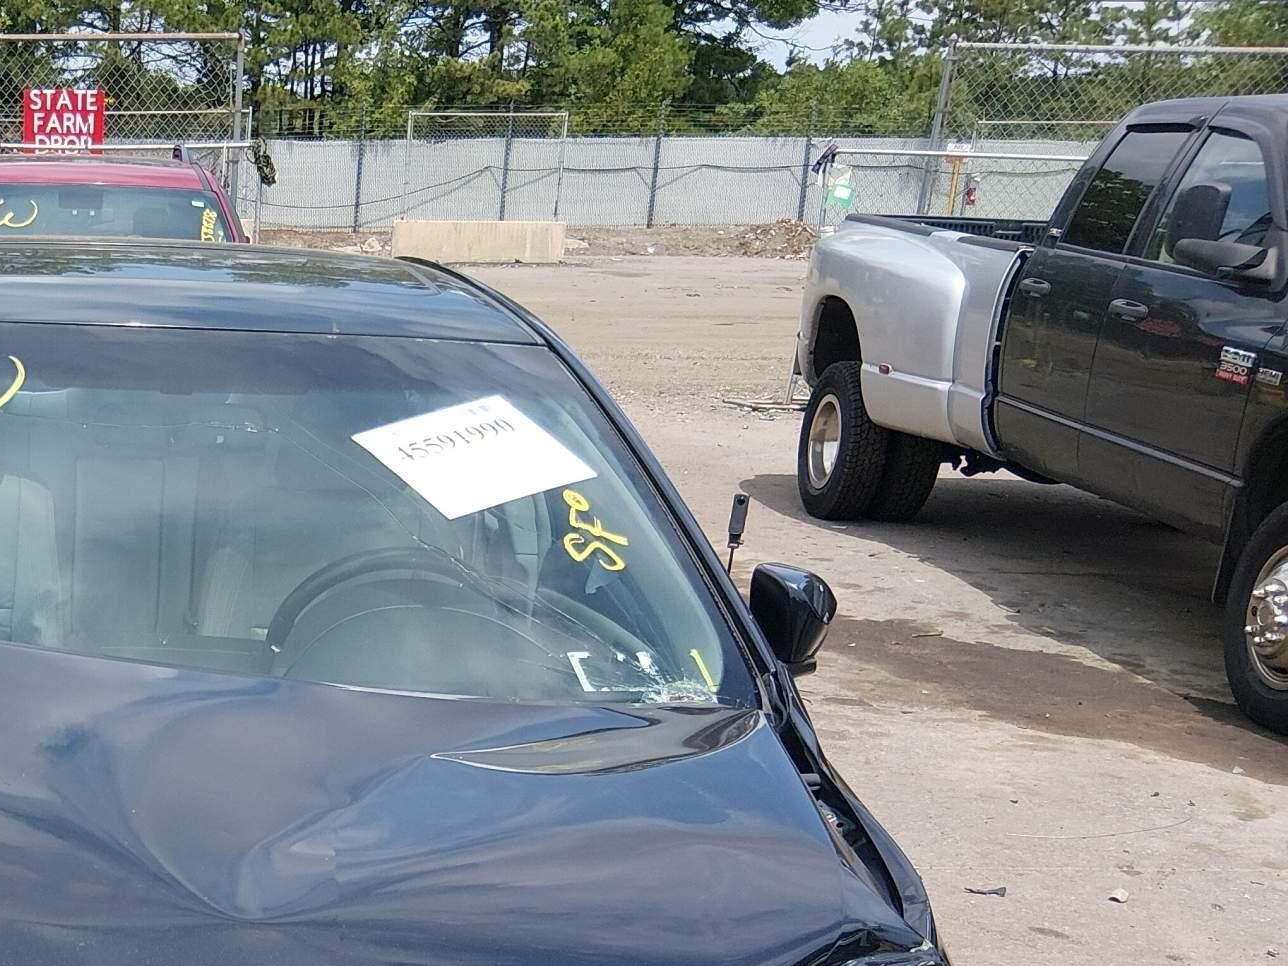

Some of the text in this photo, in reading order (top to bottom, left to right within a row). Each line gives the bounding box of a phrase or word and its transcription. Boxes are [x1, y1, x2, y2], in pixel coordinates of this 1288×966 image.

[29, 88, 98, 111] STATE
[33, 112, 95, 134] FARM
[1219, 361, 1248, 376] 3500
